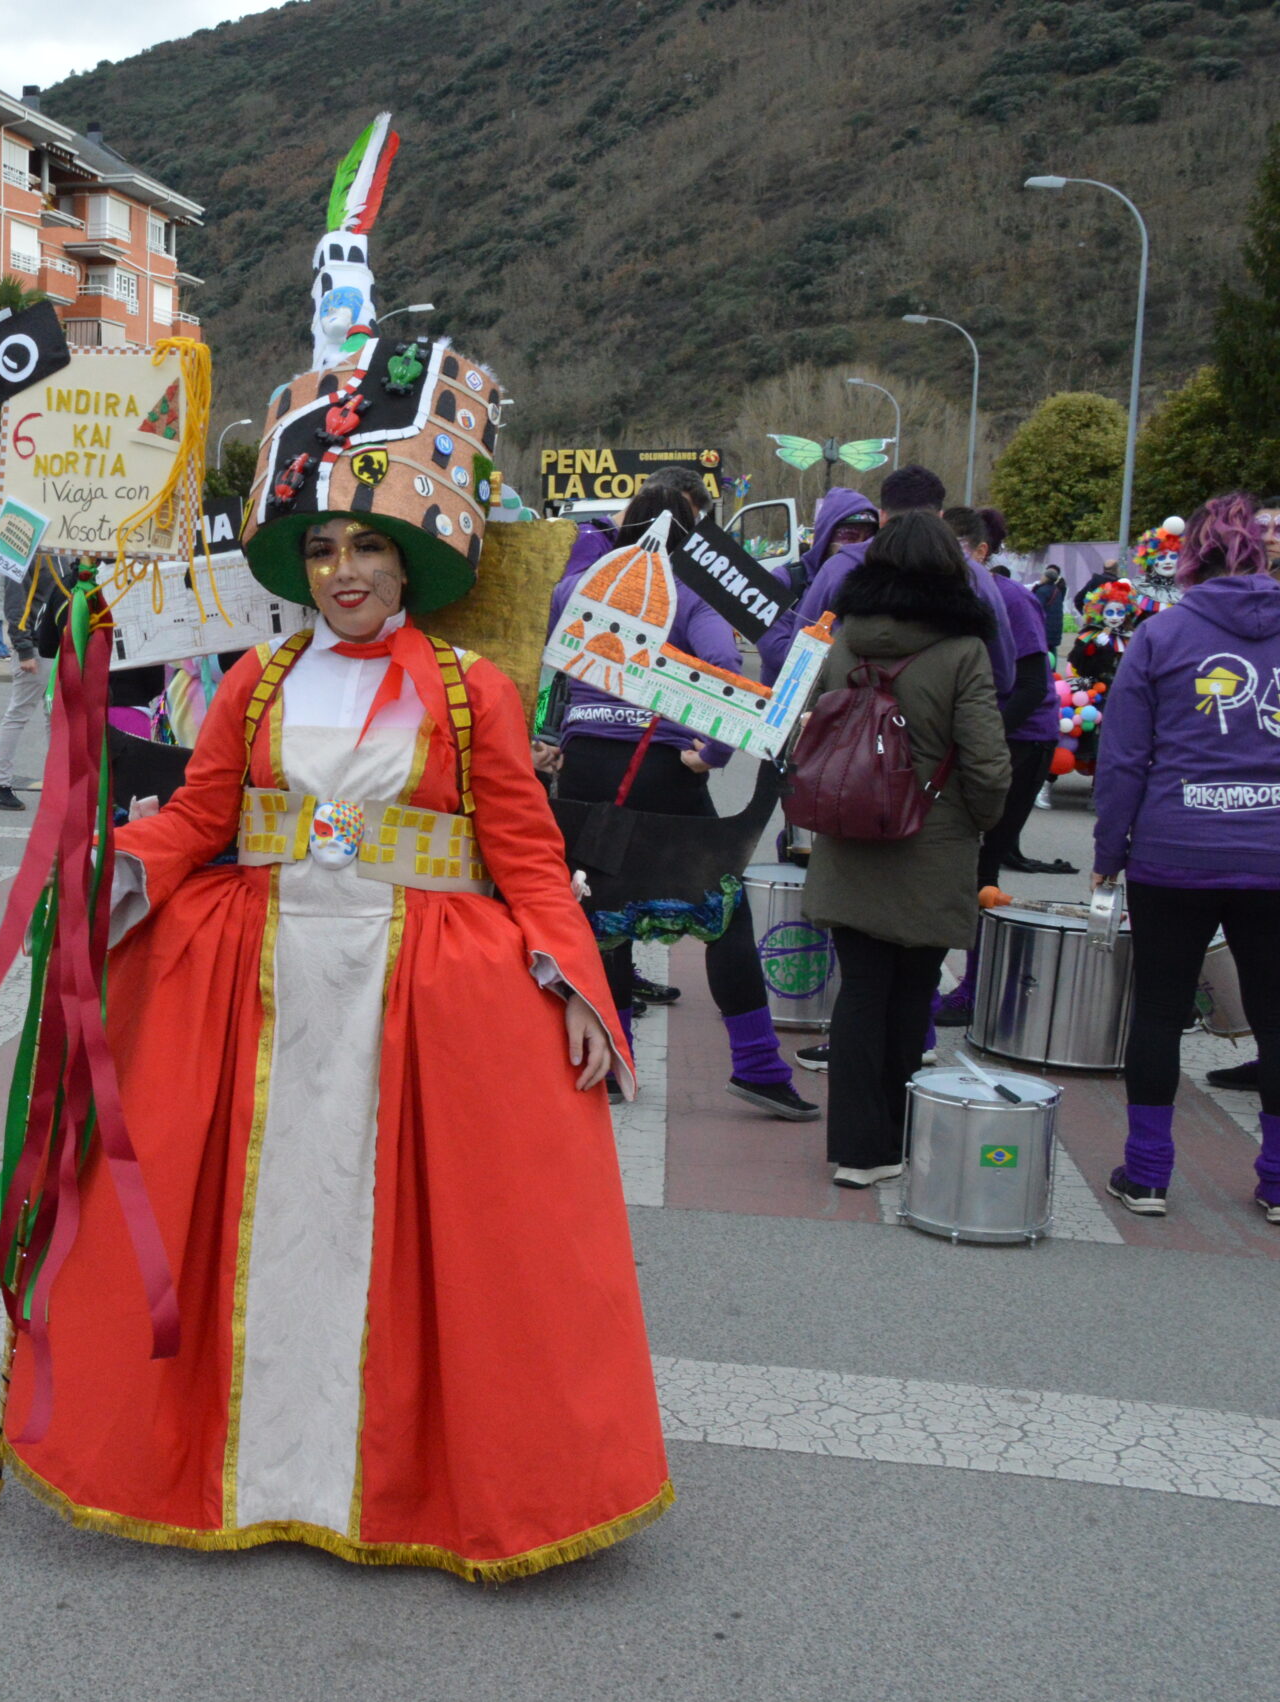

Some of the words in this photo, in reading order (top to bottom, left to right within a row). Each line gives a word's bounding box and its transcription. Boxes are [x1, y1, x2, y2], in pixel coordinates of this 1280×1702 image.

[46, 387, 139, 417] INDIRA
[13, 413, 43, 460] 6
[73, 423, 111, 449] KAI
[33, 451, 126, 478] NORTIA
[115, 485, 149, 501] con
[548, 475, 586, 499] LA
[594, 473, 720, 498] CORA
[683, 532, 779, 627] FLORENCIA
[1186, 786, 1280, 809] PIKAMBOR
